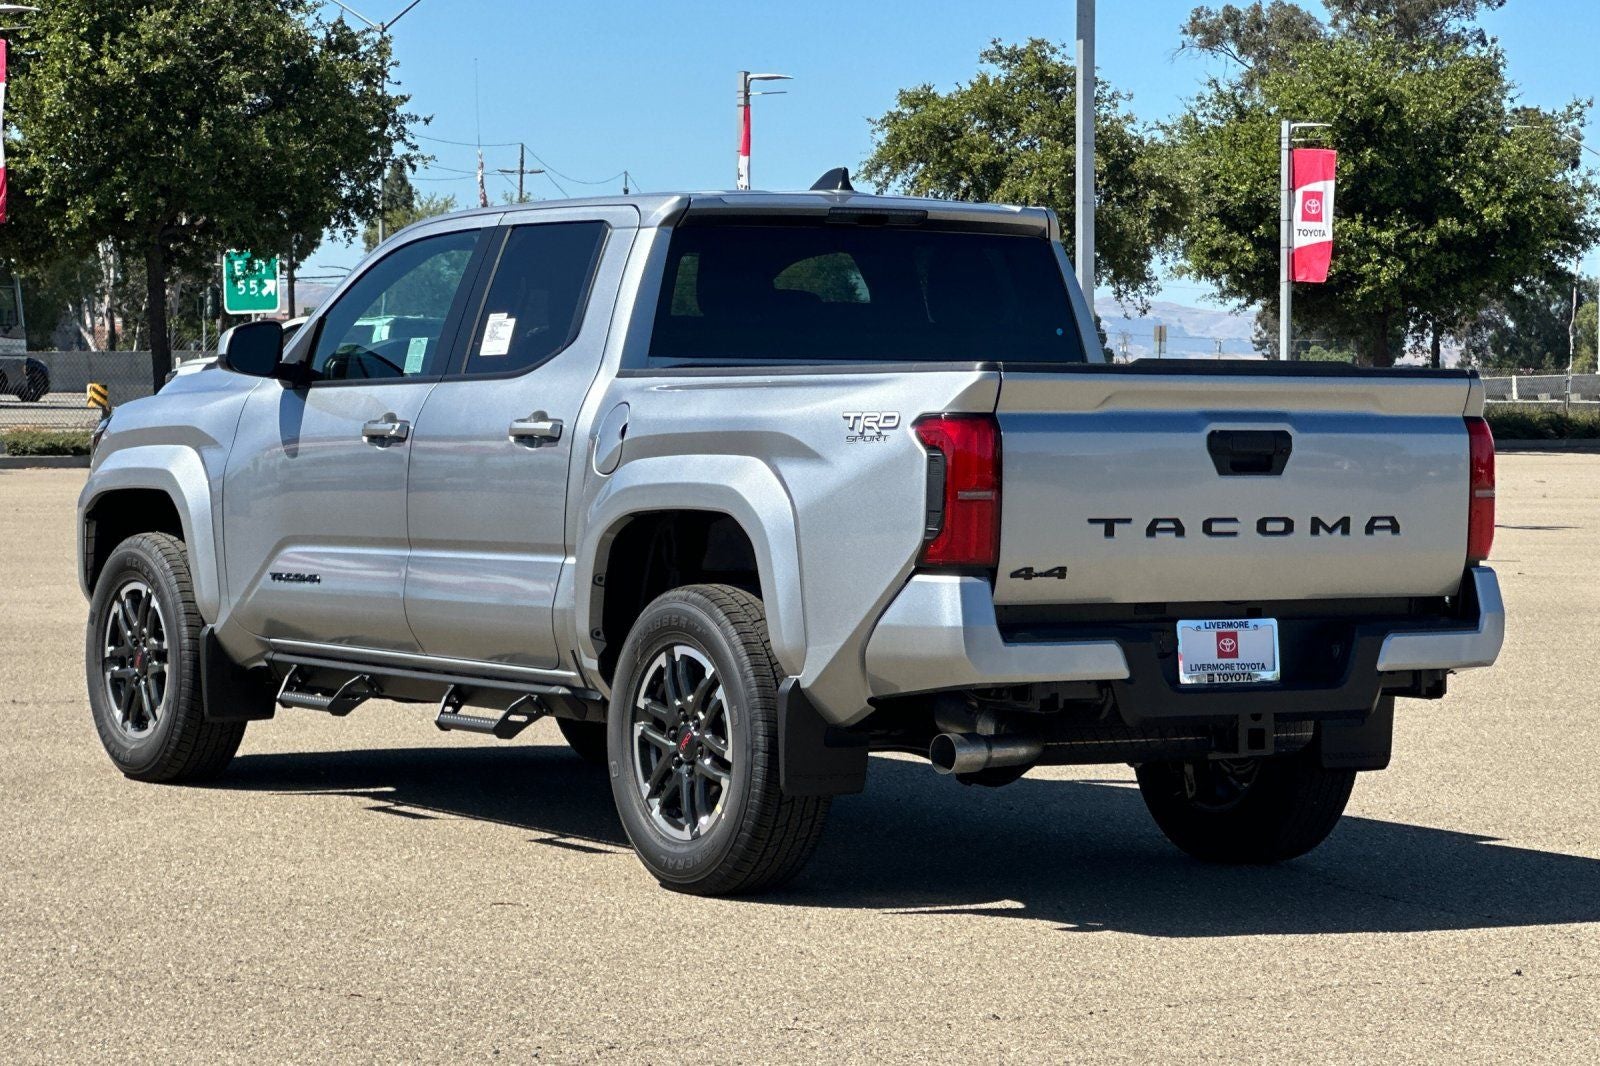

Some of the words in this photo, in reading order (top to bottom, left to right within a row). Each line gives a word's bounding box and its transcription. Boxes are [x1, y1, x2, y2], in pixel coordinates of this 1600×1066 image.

[1297, 229, 1326, 237] TOYOTA
[843, 411, 900, 434] TRD
[846, 434, 890, 443] SPORT
[1087, 515, 1401, 538] TACOMA
[1204, 620, 1249, 630] LIVERMORE
[1189, 663, 1236, 672] LIVERMORE
[1236, 662, 1267, 671] TOYOTA
[1216, 673, 1253, 682] TOYOTA
